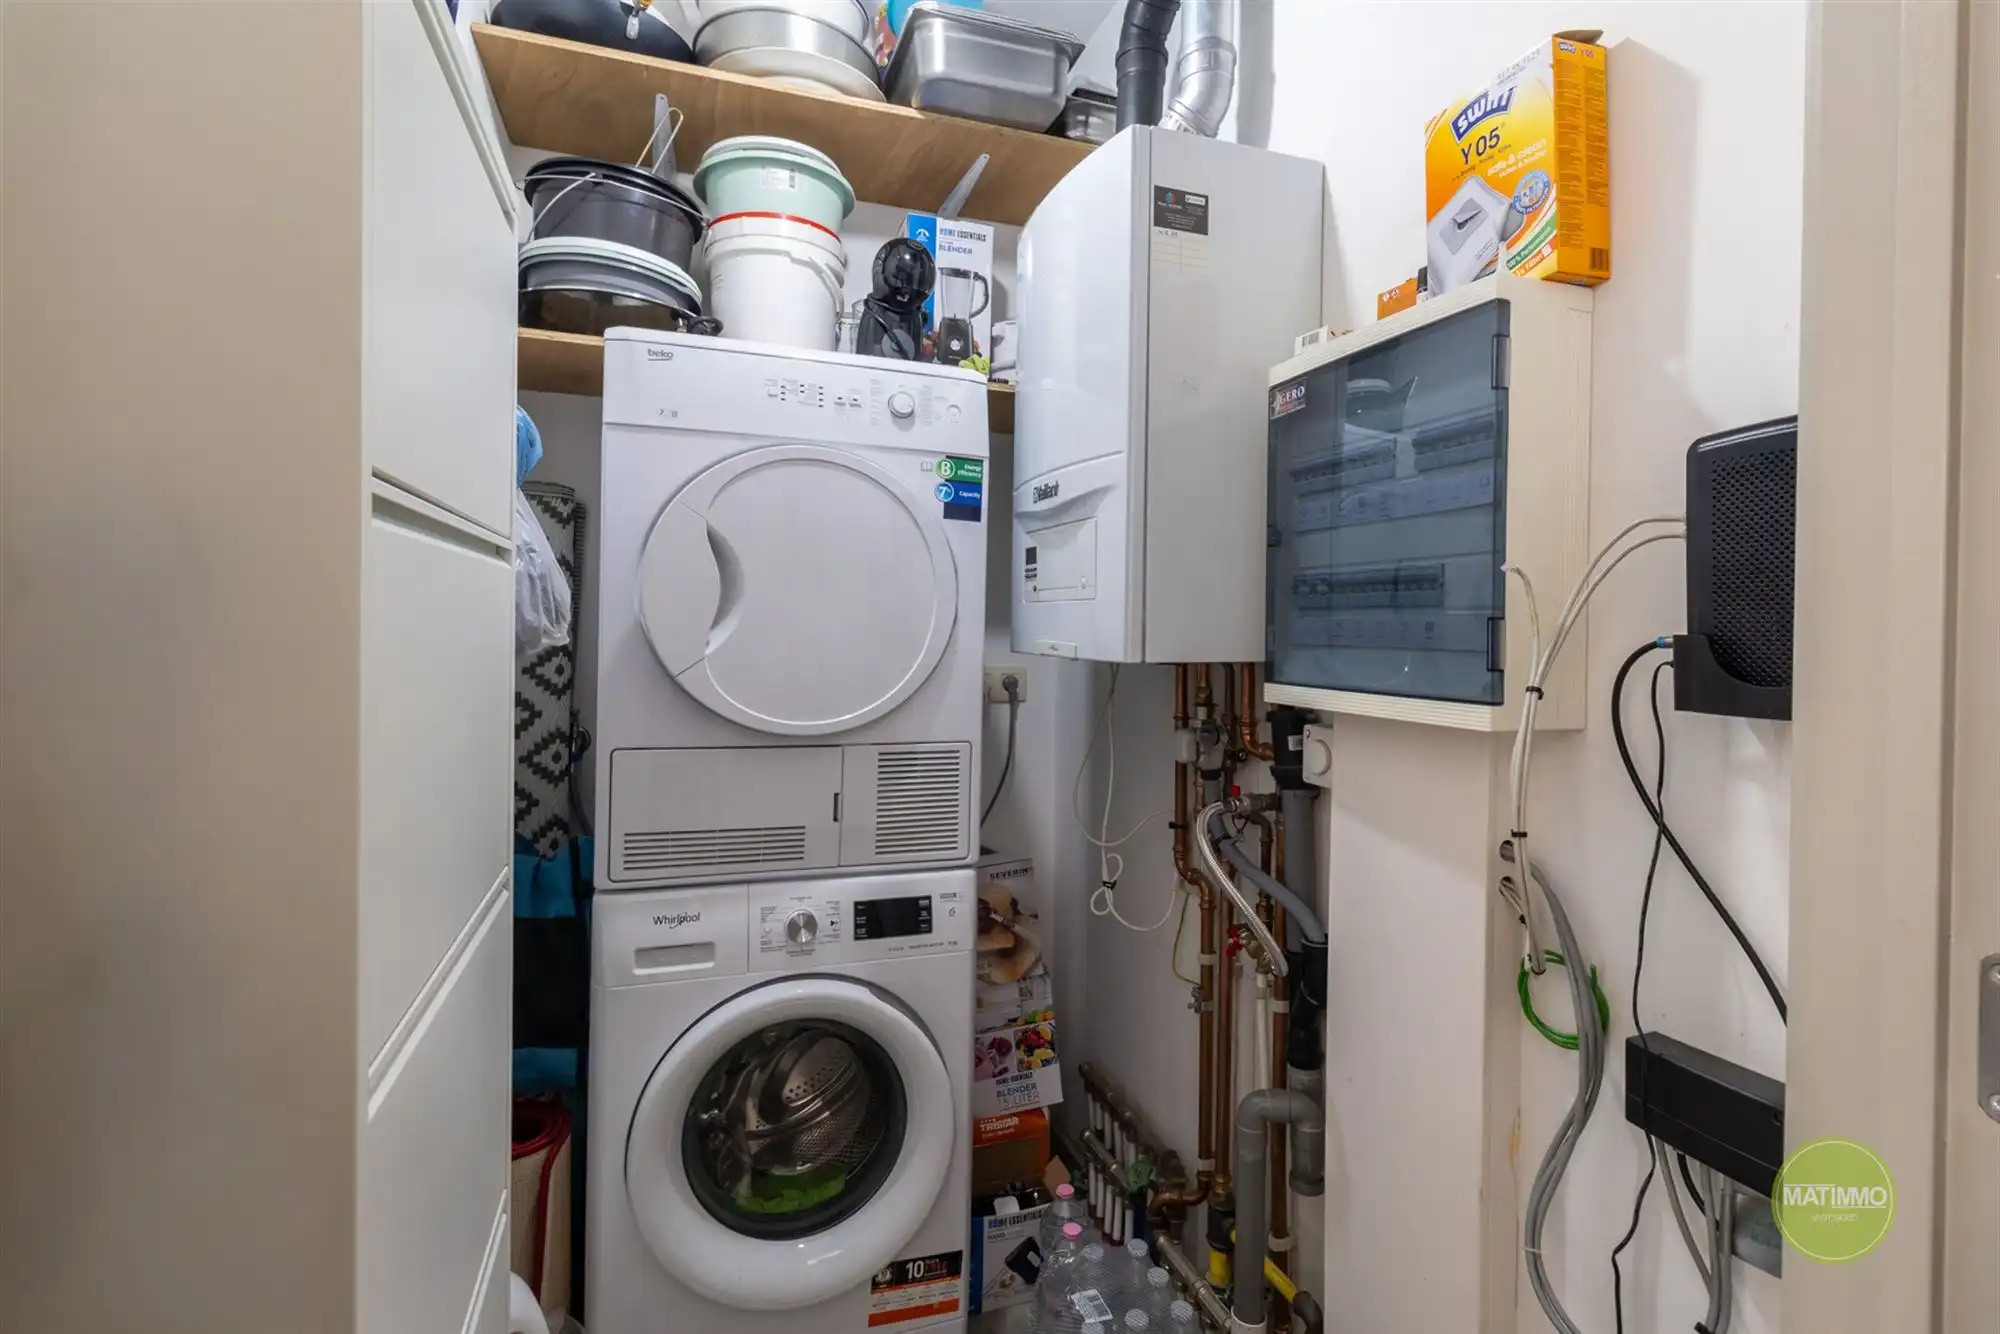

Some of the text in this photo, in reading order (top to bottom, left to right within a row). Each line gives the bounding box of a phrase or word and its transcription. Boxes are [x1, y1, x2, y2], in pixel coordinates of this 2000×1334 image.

[1461, 143, 1473, 165] Y
[1476, 126, 1500, 157] 05
[957, 230, 986, 242] ESSENTIALS
[939, 244, 973, 255] BLENDER
[648, 349, 673, 358] beko
[940, 461, 951, 476] B
[652, 911, 701, 929] Whirlpool
[997, 1082, 1037, 1098] BLENDER
[989, 1210, 1042, 1229] HOME ESSENTIALS
[906, 1260, 924, 1279] 10
